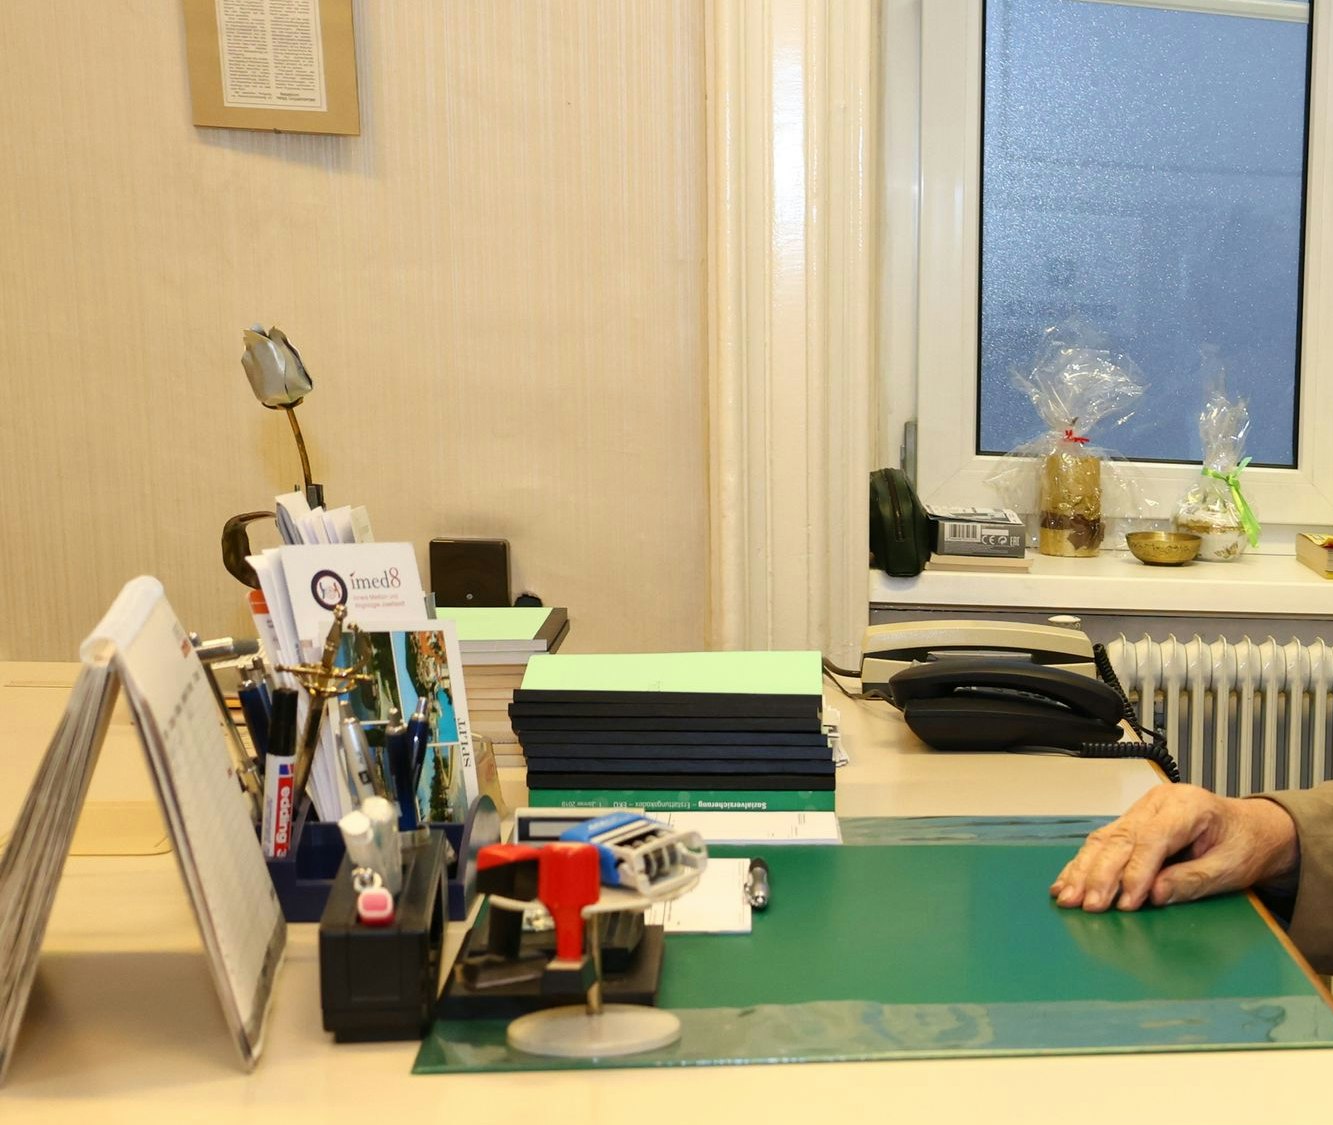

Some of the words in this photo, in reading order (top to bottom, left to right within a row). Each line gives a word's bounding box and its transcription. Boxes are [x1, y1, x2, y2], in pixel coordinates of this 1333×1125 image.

[457, 717, 471, 768] SPLIT
[276, 786, 292, 845] edding
[635, 800, 691, 810] Erstattungskodex
[698, 800, 767, 810] Sozialversicherung
